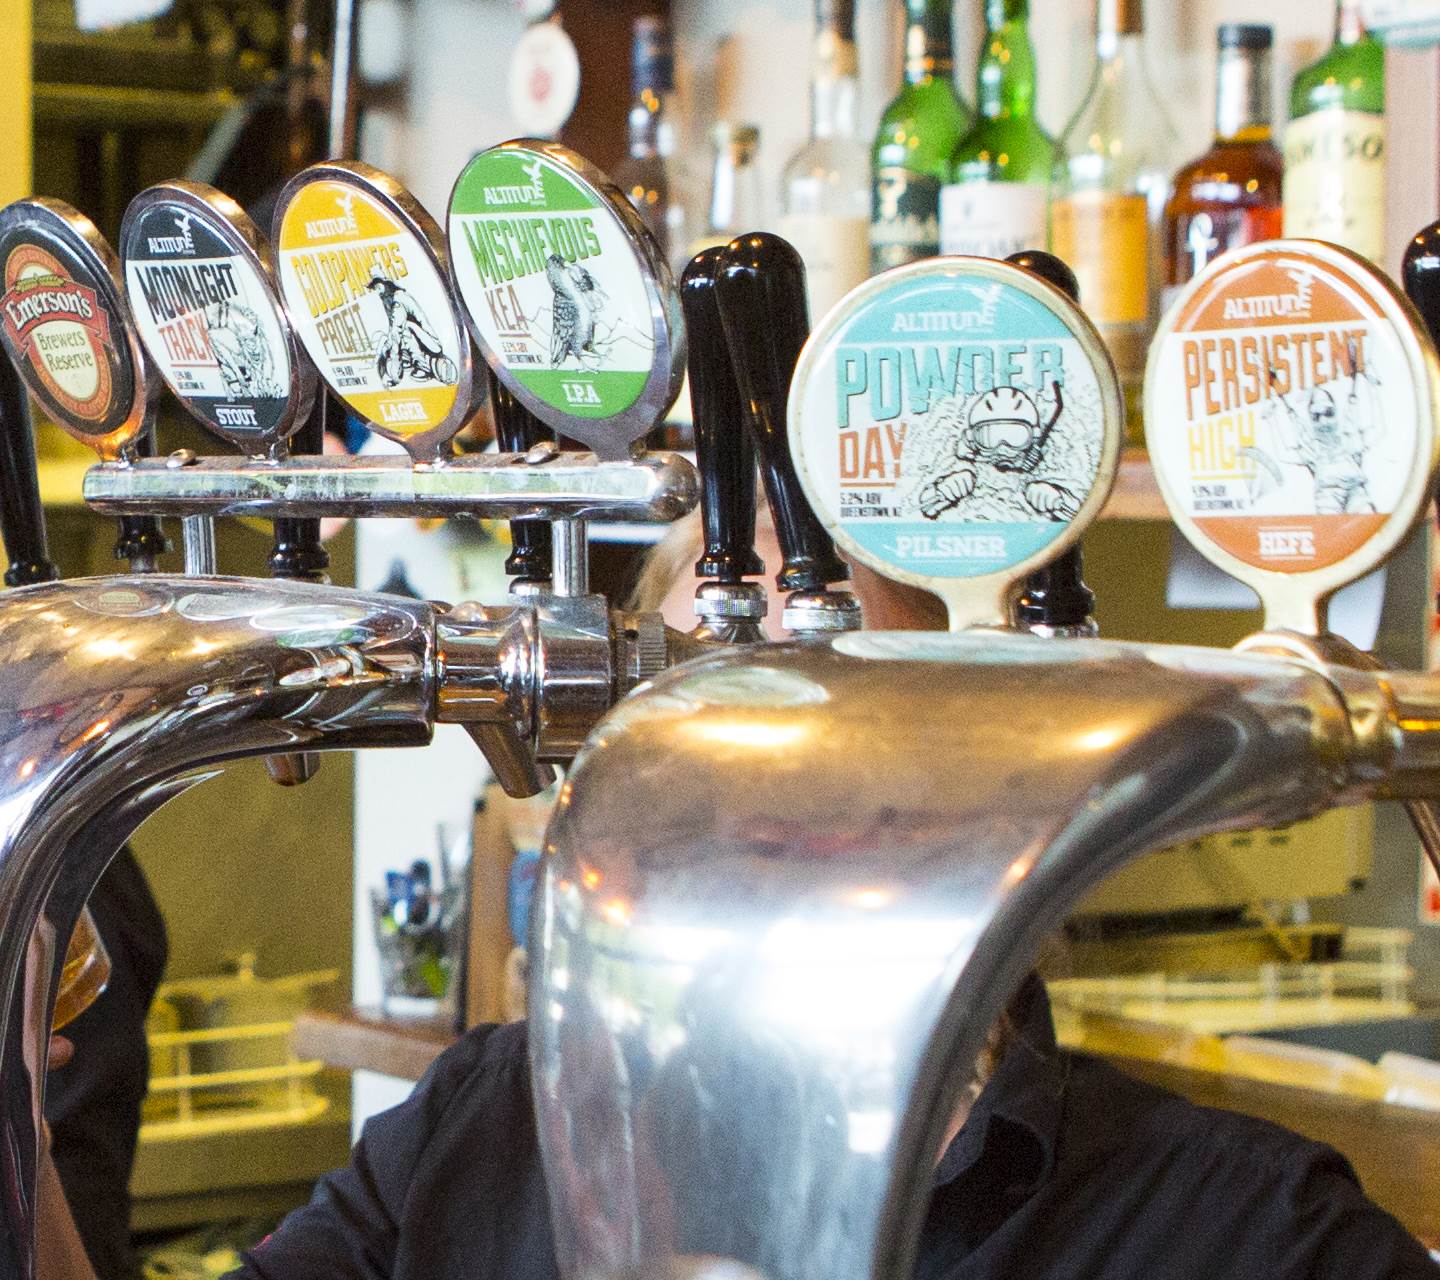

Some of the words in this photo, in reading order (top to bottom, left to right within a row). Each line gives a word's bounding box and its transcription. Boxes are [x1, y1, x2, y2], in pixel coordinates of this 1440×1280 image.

[483, 183, 546, 206] ALTITUDE
[148, 232, 195, 254] ALTITUDE
[305, 218, 358, 240] ALTITUDE
[462, 217, 602, 288] MISCHIEVOUS
[135, 263, 238, 325] MOONLIGHT
[290, 241, 409, 318] GOLDPANNERS
[6, 290, 93, 330] Emerson's
[485, 285, 529, 331] KEA
[892, 308, 995, 333] ALTITUDE
[1224, 290, 1312, 319] ALTITUDE
[37, 329, 85, 350] Brewers
[158, 312, 219, 361] TRACK
[315, 303, 372, 356] PROFIT
[48, 353, 93, 371] Reserve
[1182, 330, 1368, 421] PERSISTENT
[836, 344, 1066, 428] POWDER
[215, 408, 258, 425] STOUT
[379, 402, 429, 422] LAGER
[839, 423, 907, 479] DAY
[1188, 414, 1256, 471] HIGH
[895, 535, 1007, 558] PILSNER
